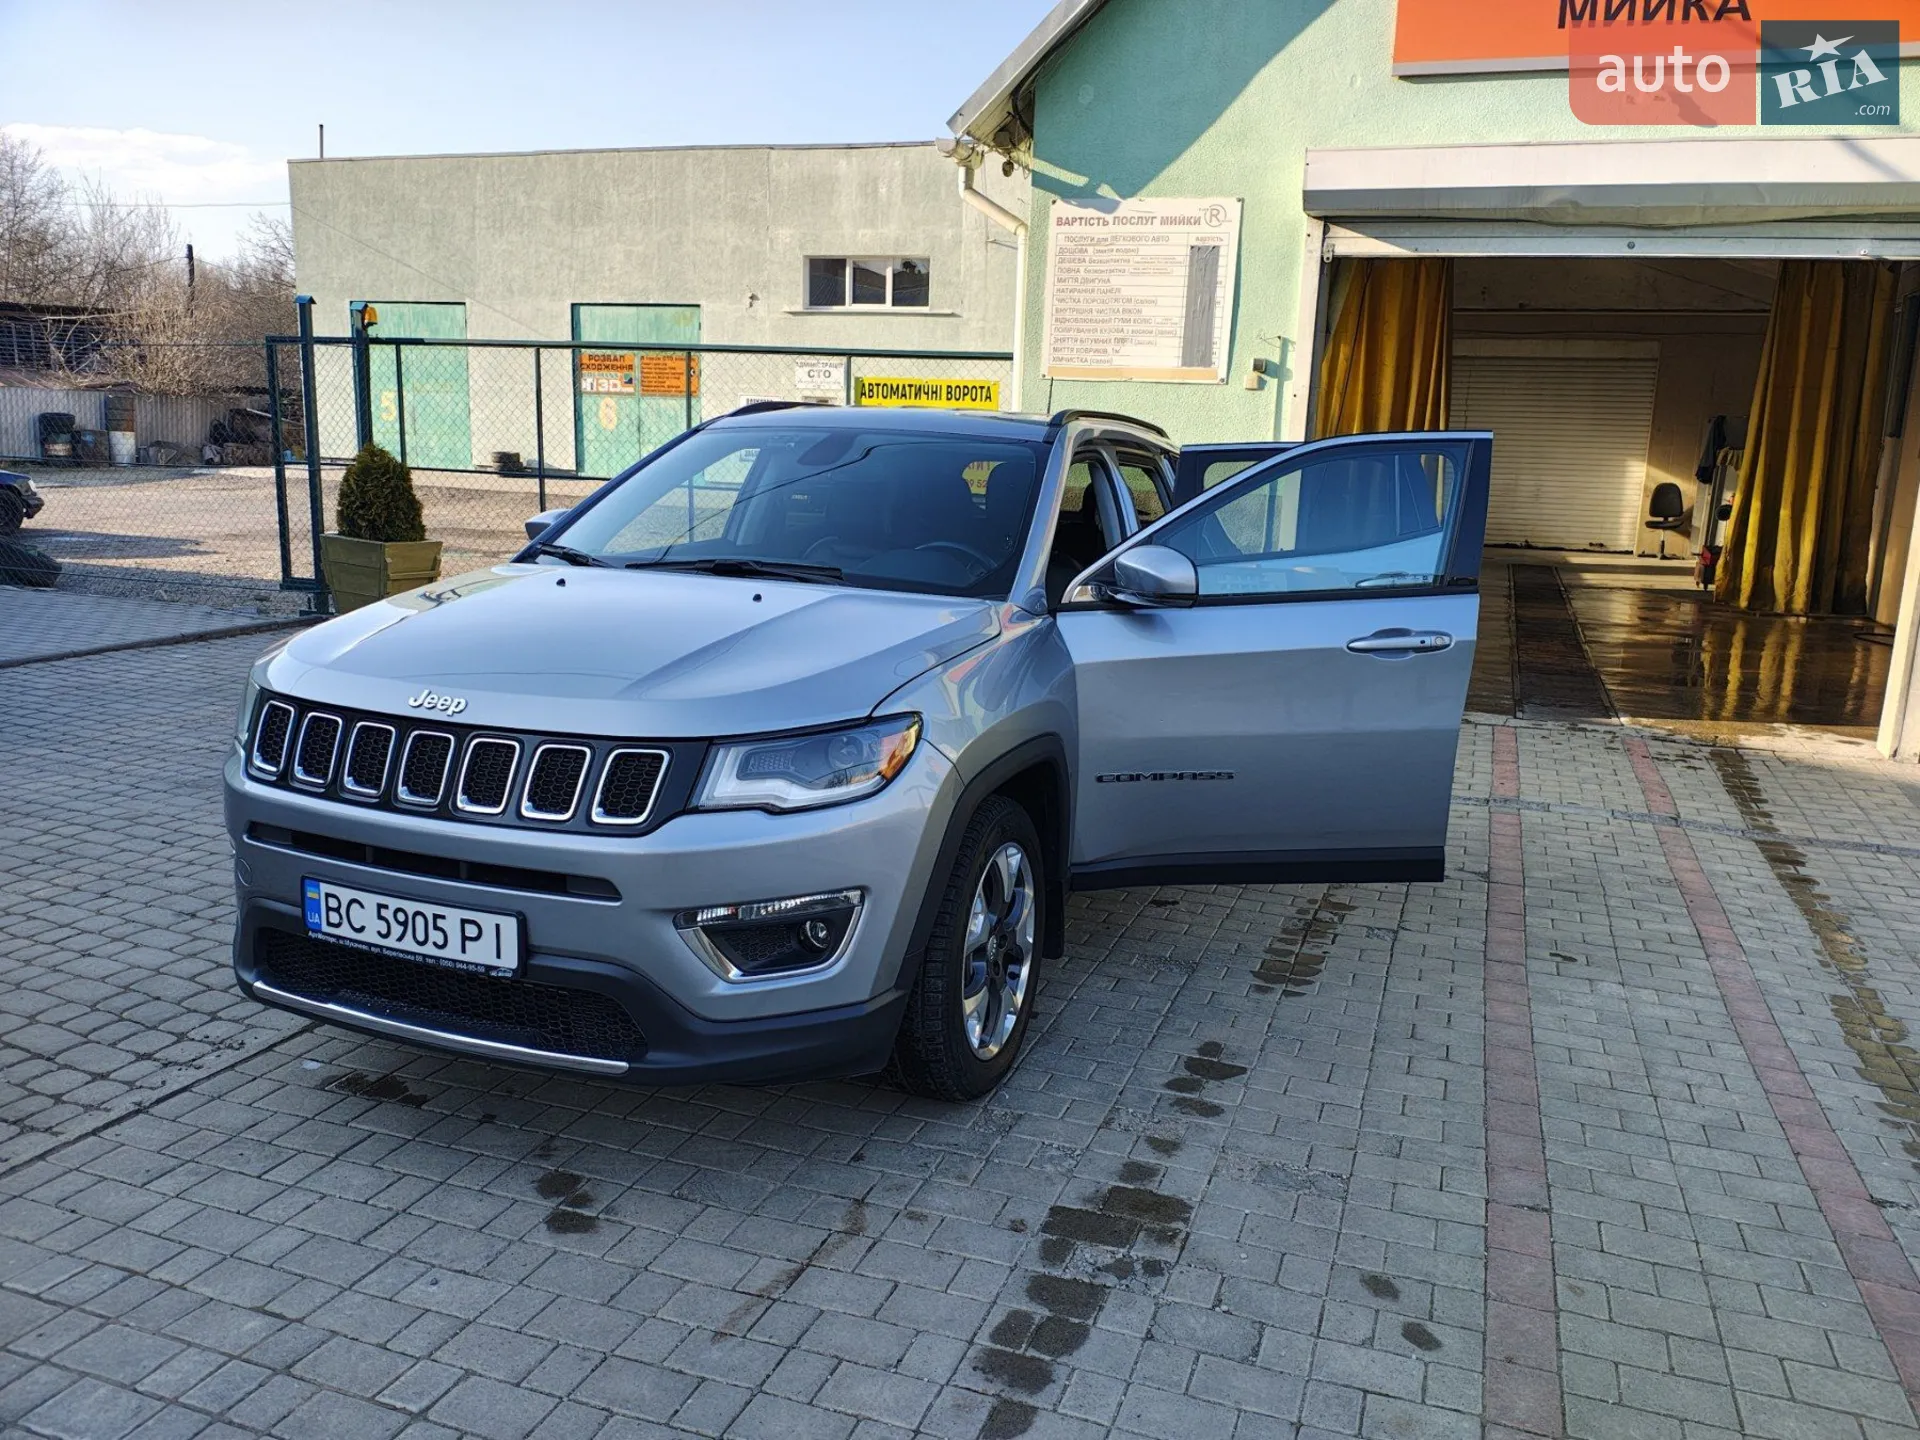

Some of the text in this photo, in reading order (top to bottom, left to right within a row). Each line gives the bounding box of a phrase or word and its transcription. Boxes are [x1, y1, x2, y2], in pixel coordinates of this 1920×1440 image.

[1056, 214, 1201, 227] ВАРТІСТЬ ПОСЛУГ МИЙКИ
[807, 369, 831, 379] СТО
[860, 382, 993, 402] АВТОМАТИЧНІ ВОРОТА
[408, 688, 468, 717] Jeep
[1095, 771, 1236, 784] COMPASS
[307, 911, 320, 924] UA
[324, 891, 366, 934] BC
[376, 902, 449, 950] 5905
